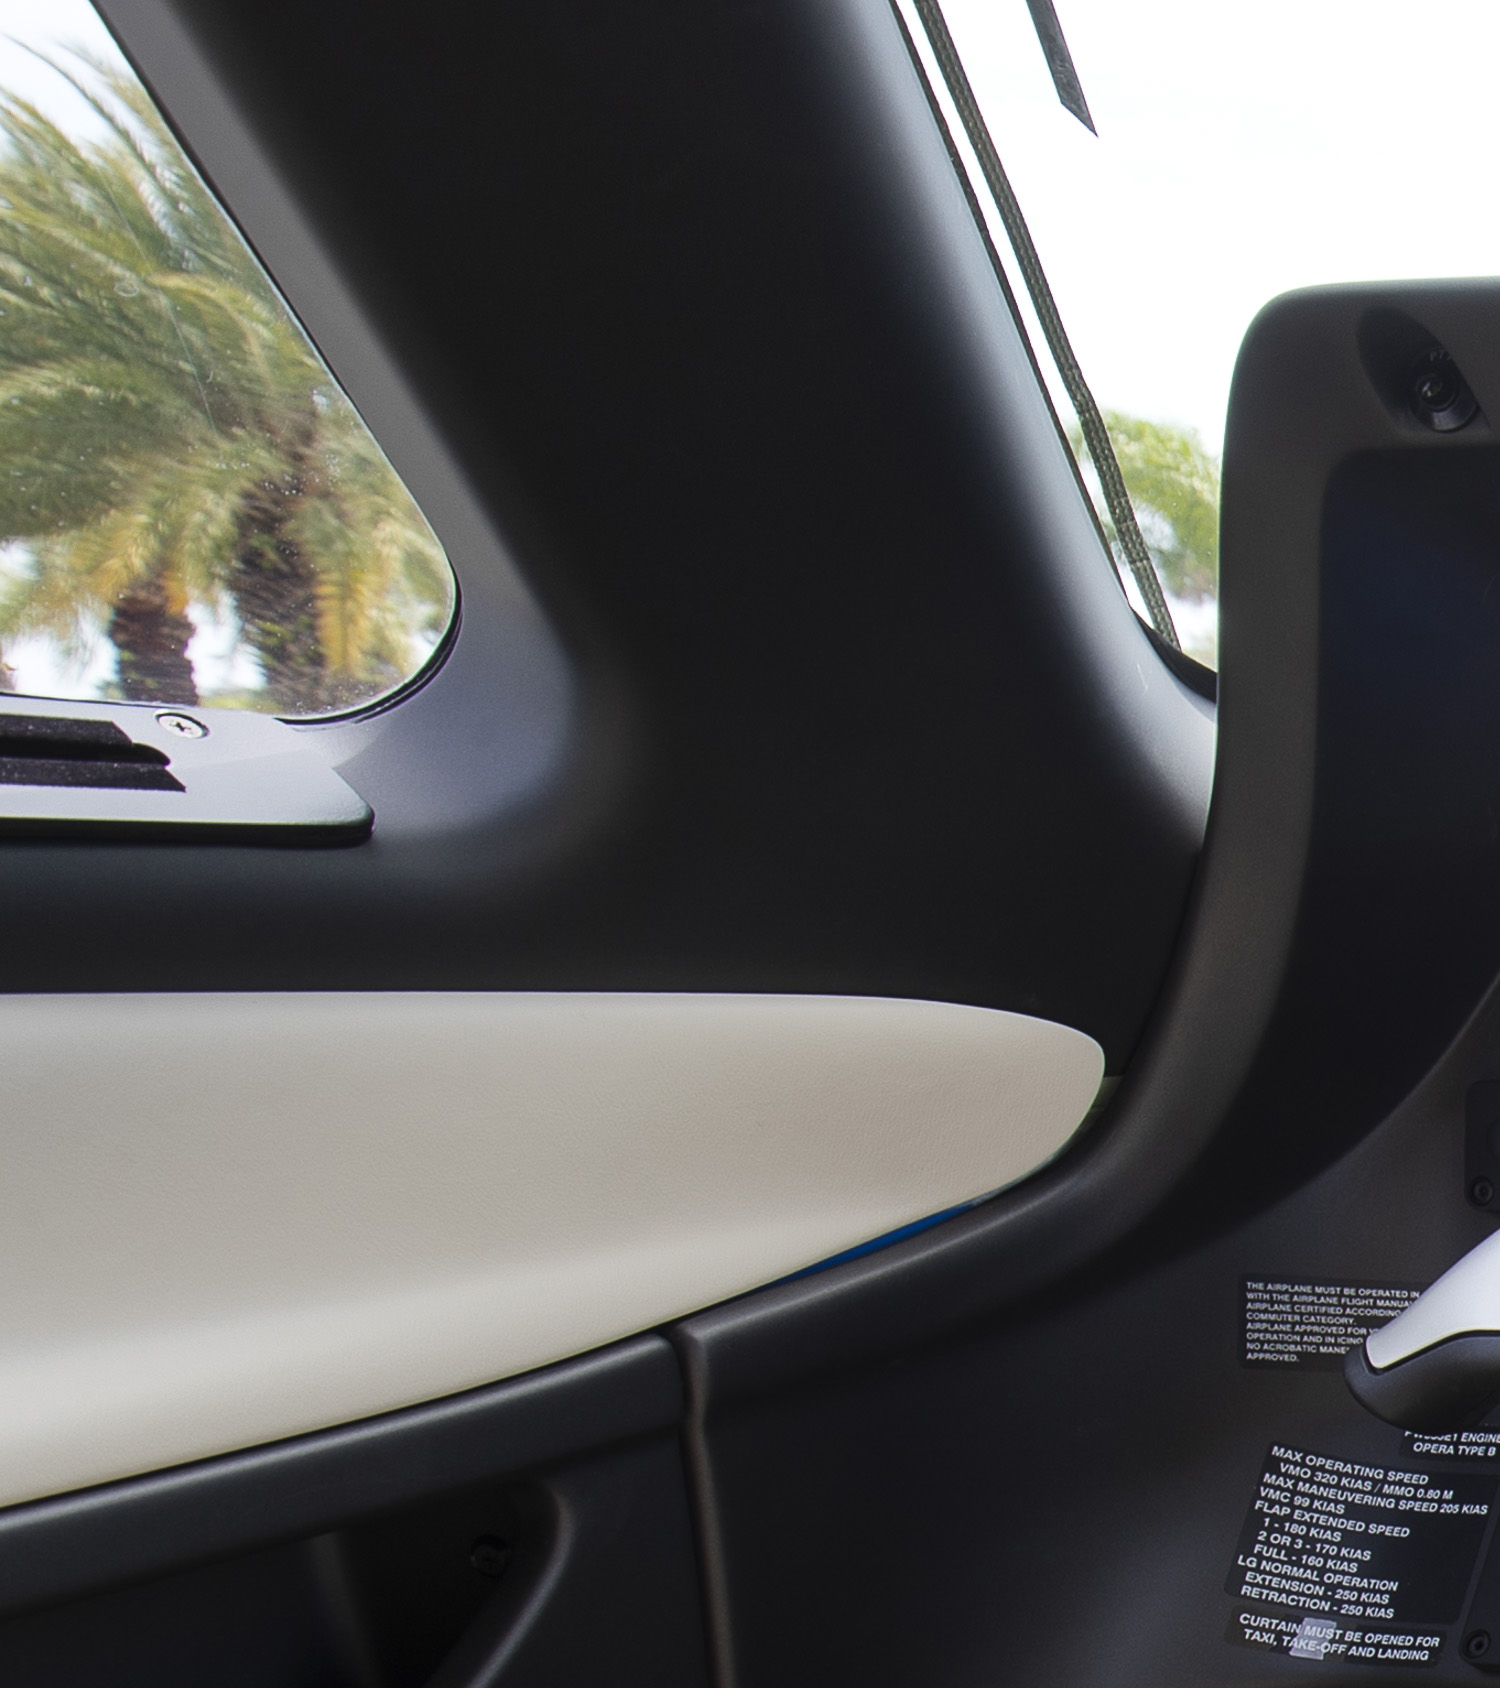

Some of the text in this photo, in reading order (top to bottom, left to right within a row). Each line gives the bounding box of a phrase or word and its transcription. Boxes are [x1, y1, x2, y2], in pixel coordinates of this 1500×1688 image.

[1246, 1313, 1300, 1323] COMMUTER
[1272, 1446, 1428, 1484] MAX OPERATING SPEED
[1239, 1613, 1440, 1647] CURTAIN MUST BE OPENED FOR
[1244, 1629, 1429, 1660] TAXI, TAKE-OFF AND LANDING
